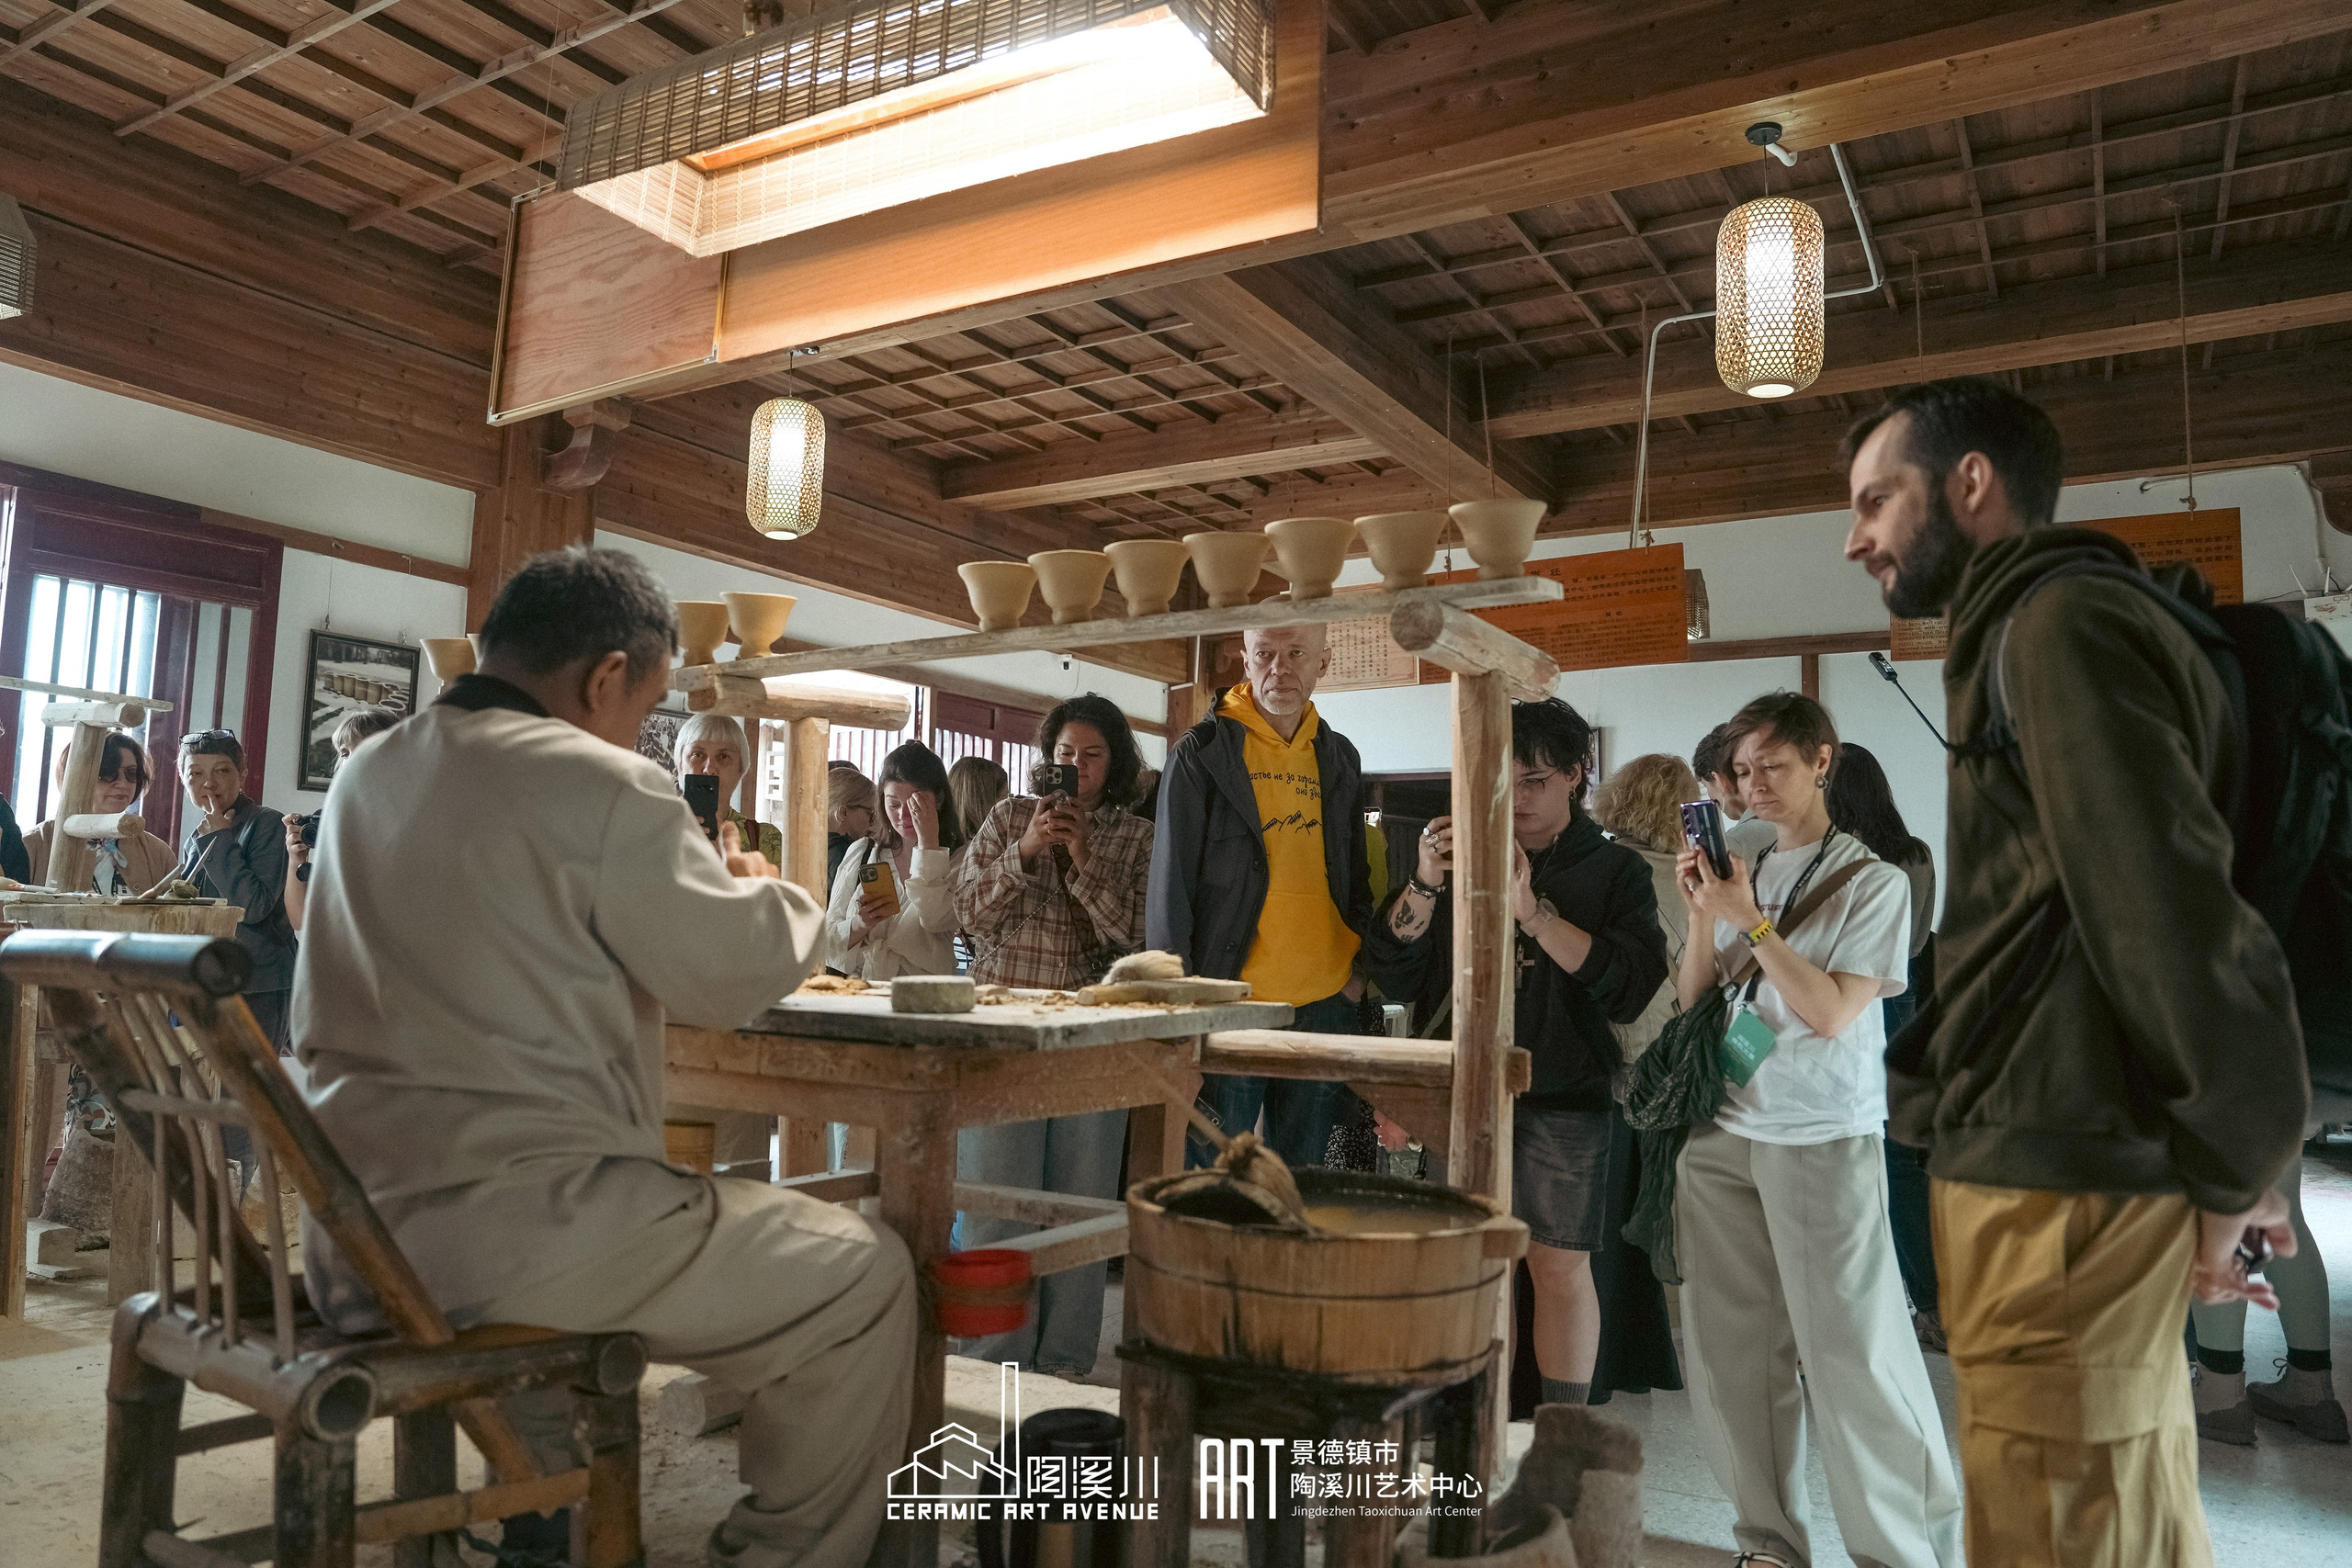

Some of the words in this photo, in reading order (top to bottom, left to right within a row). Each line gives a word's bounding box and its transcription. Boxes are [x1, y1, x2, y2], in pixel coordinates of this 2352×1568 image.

[1249, 772, 1272, 780] астье
[1285, 772, 1295, 784] за
[1295, 787, 1308, 796] оно
